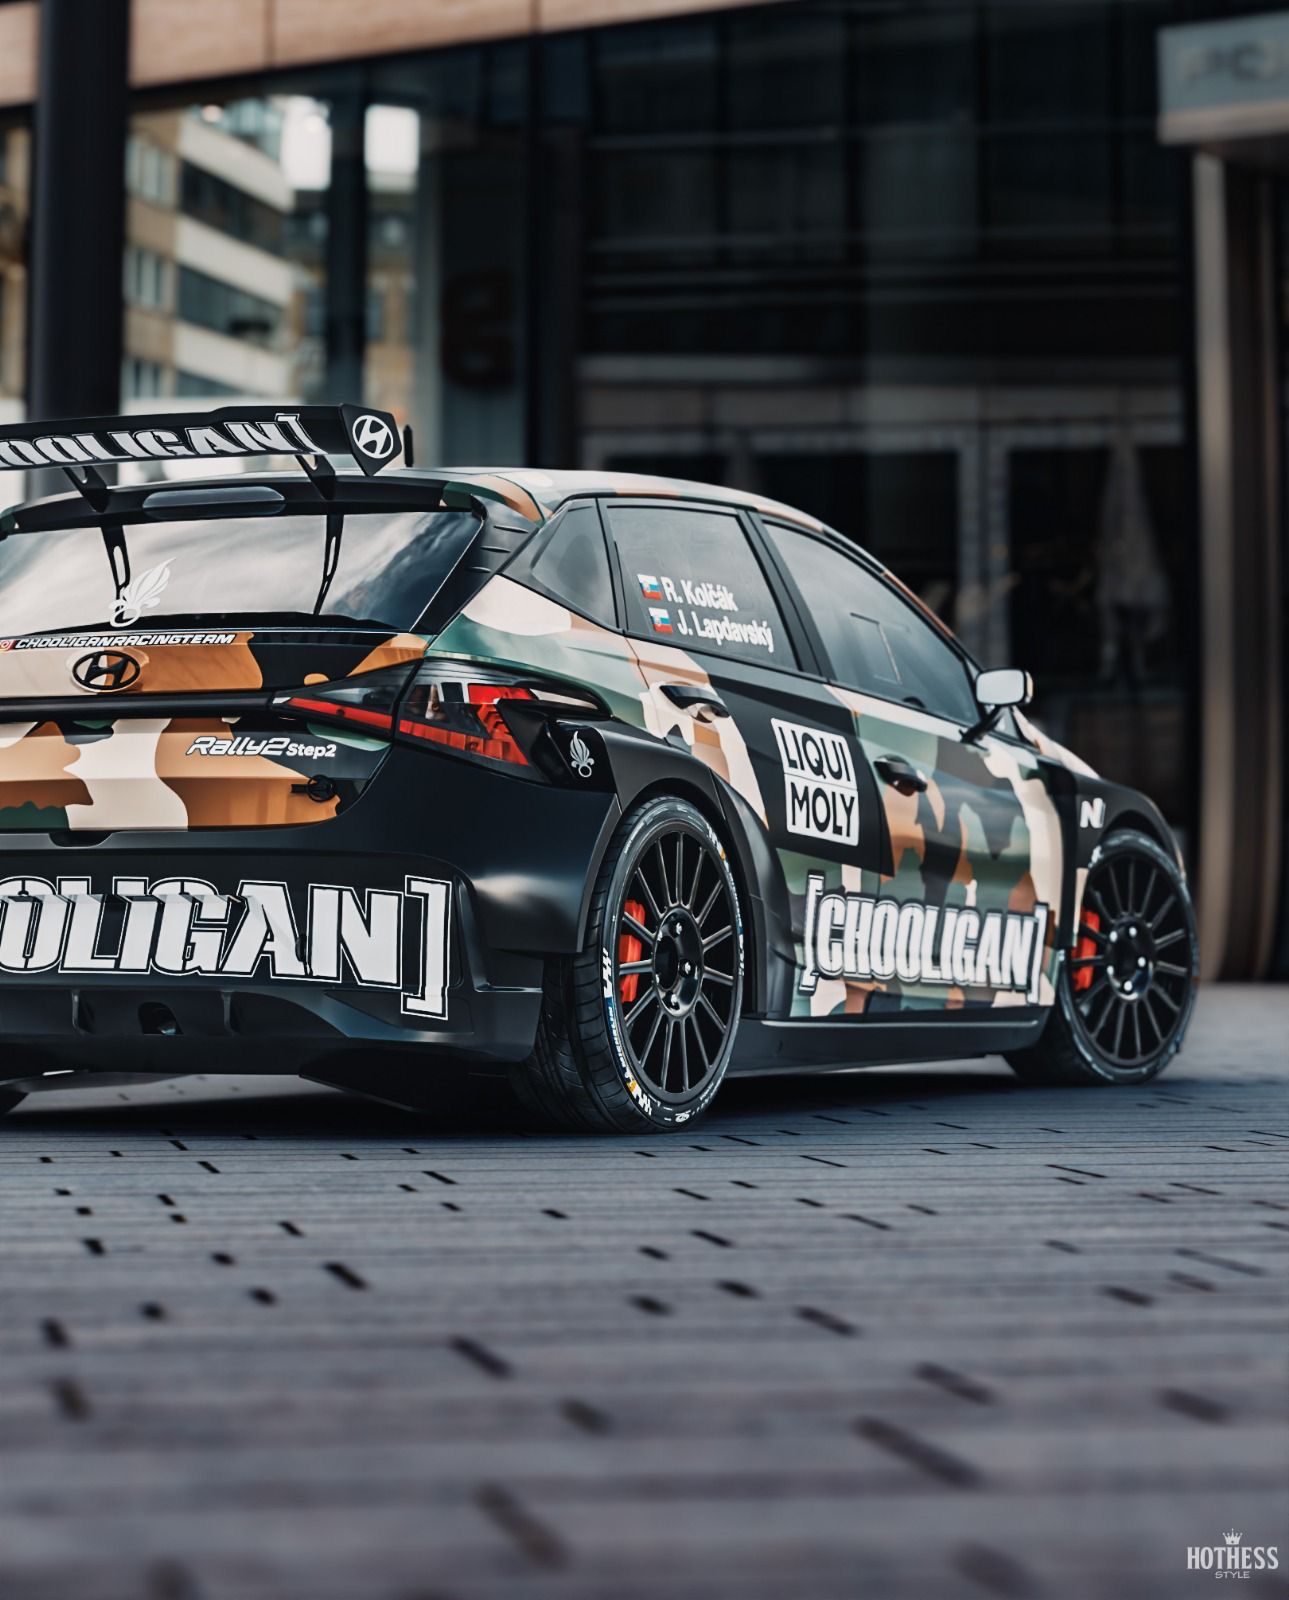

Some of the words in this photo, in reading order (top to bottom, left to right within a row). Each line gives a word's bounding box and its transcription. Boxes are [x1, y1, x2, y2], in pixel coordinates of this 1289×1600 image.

[661, 576, 683, 603] R.
[677, 610, 693, 636] J.
[16, 634, 236, 650] CHOOLIGANRACINGTEAM
[186, 736, 291, 756] Rally2
[286, 742, 337, 760] Step2
[778, 726, 850, 782] LIQUI
[791, 782, 855, 838] MOLY
